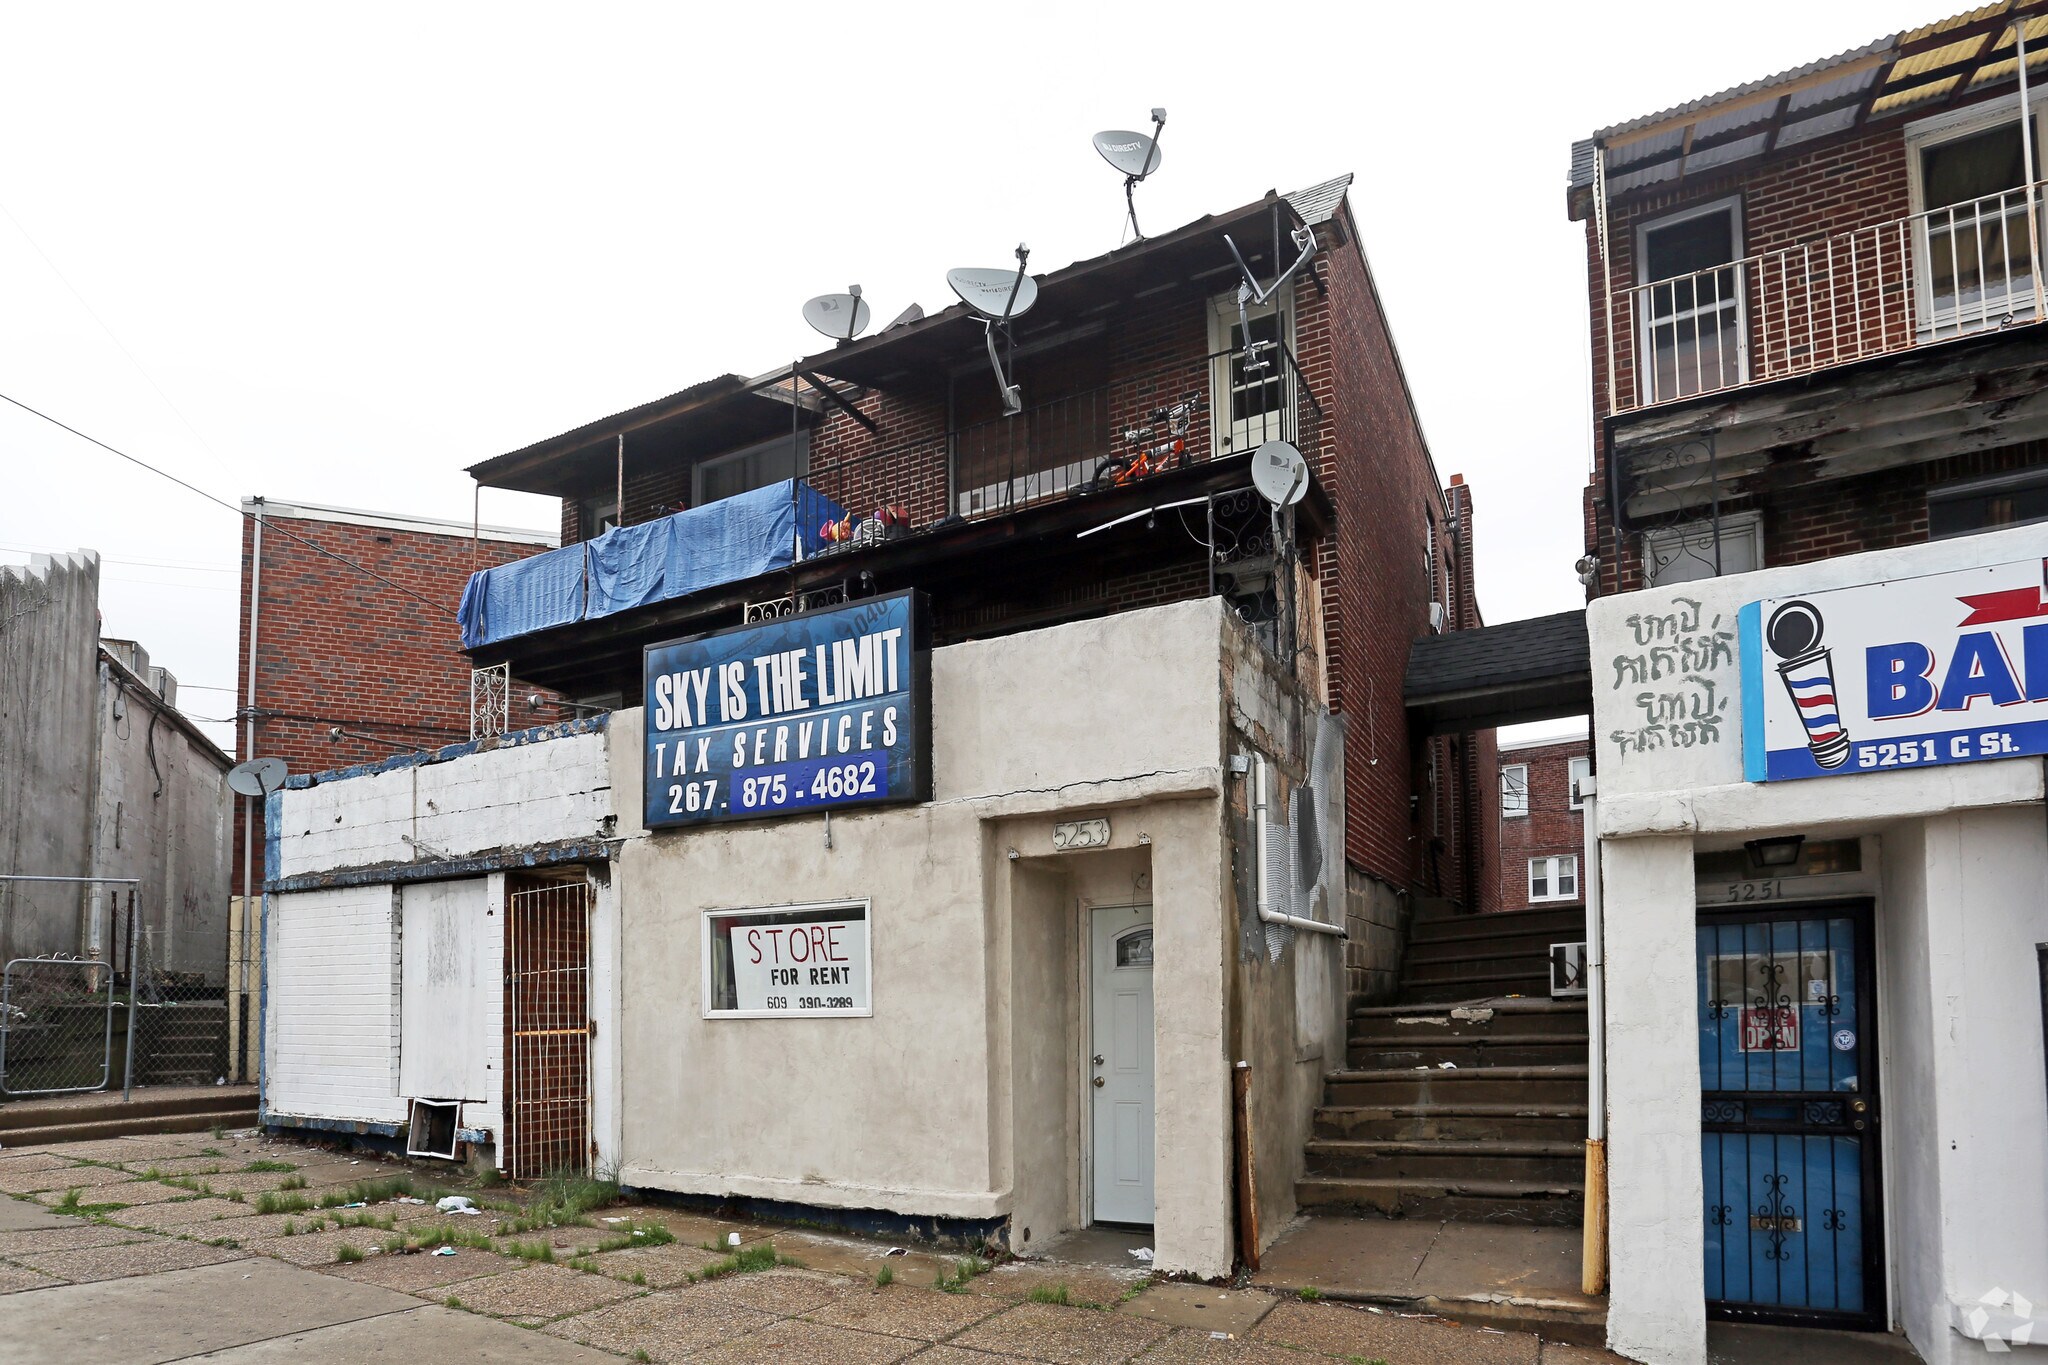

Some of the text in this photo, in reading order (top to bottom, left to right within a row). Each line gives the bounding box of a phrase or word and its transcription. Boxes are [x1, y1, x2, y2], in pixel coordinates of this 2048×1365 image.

[1111, 141, 1142, 152] DIRECTV
[655, 666, 711, 731] SKY
[718, 660, 748, 722] IS
[753, 648, 810, 716] THE
[815, 627, 902, 706] LIMIT
[655, 706, 898, 779] TAX SERVICES
[1858, 731, 2020, 768] 5251 C St.
[811, 761, 876, 799] 4682
[1054, 820, 1104, 848] 5253
[1728, 881, 1782, 902] 5251
[747, 925, 849, 964] STORE
[771, 967, 850, 986] FOR RENT
[767, 996, 788, 1009] 609
